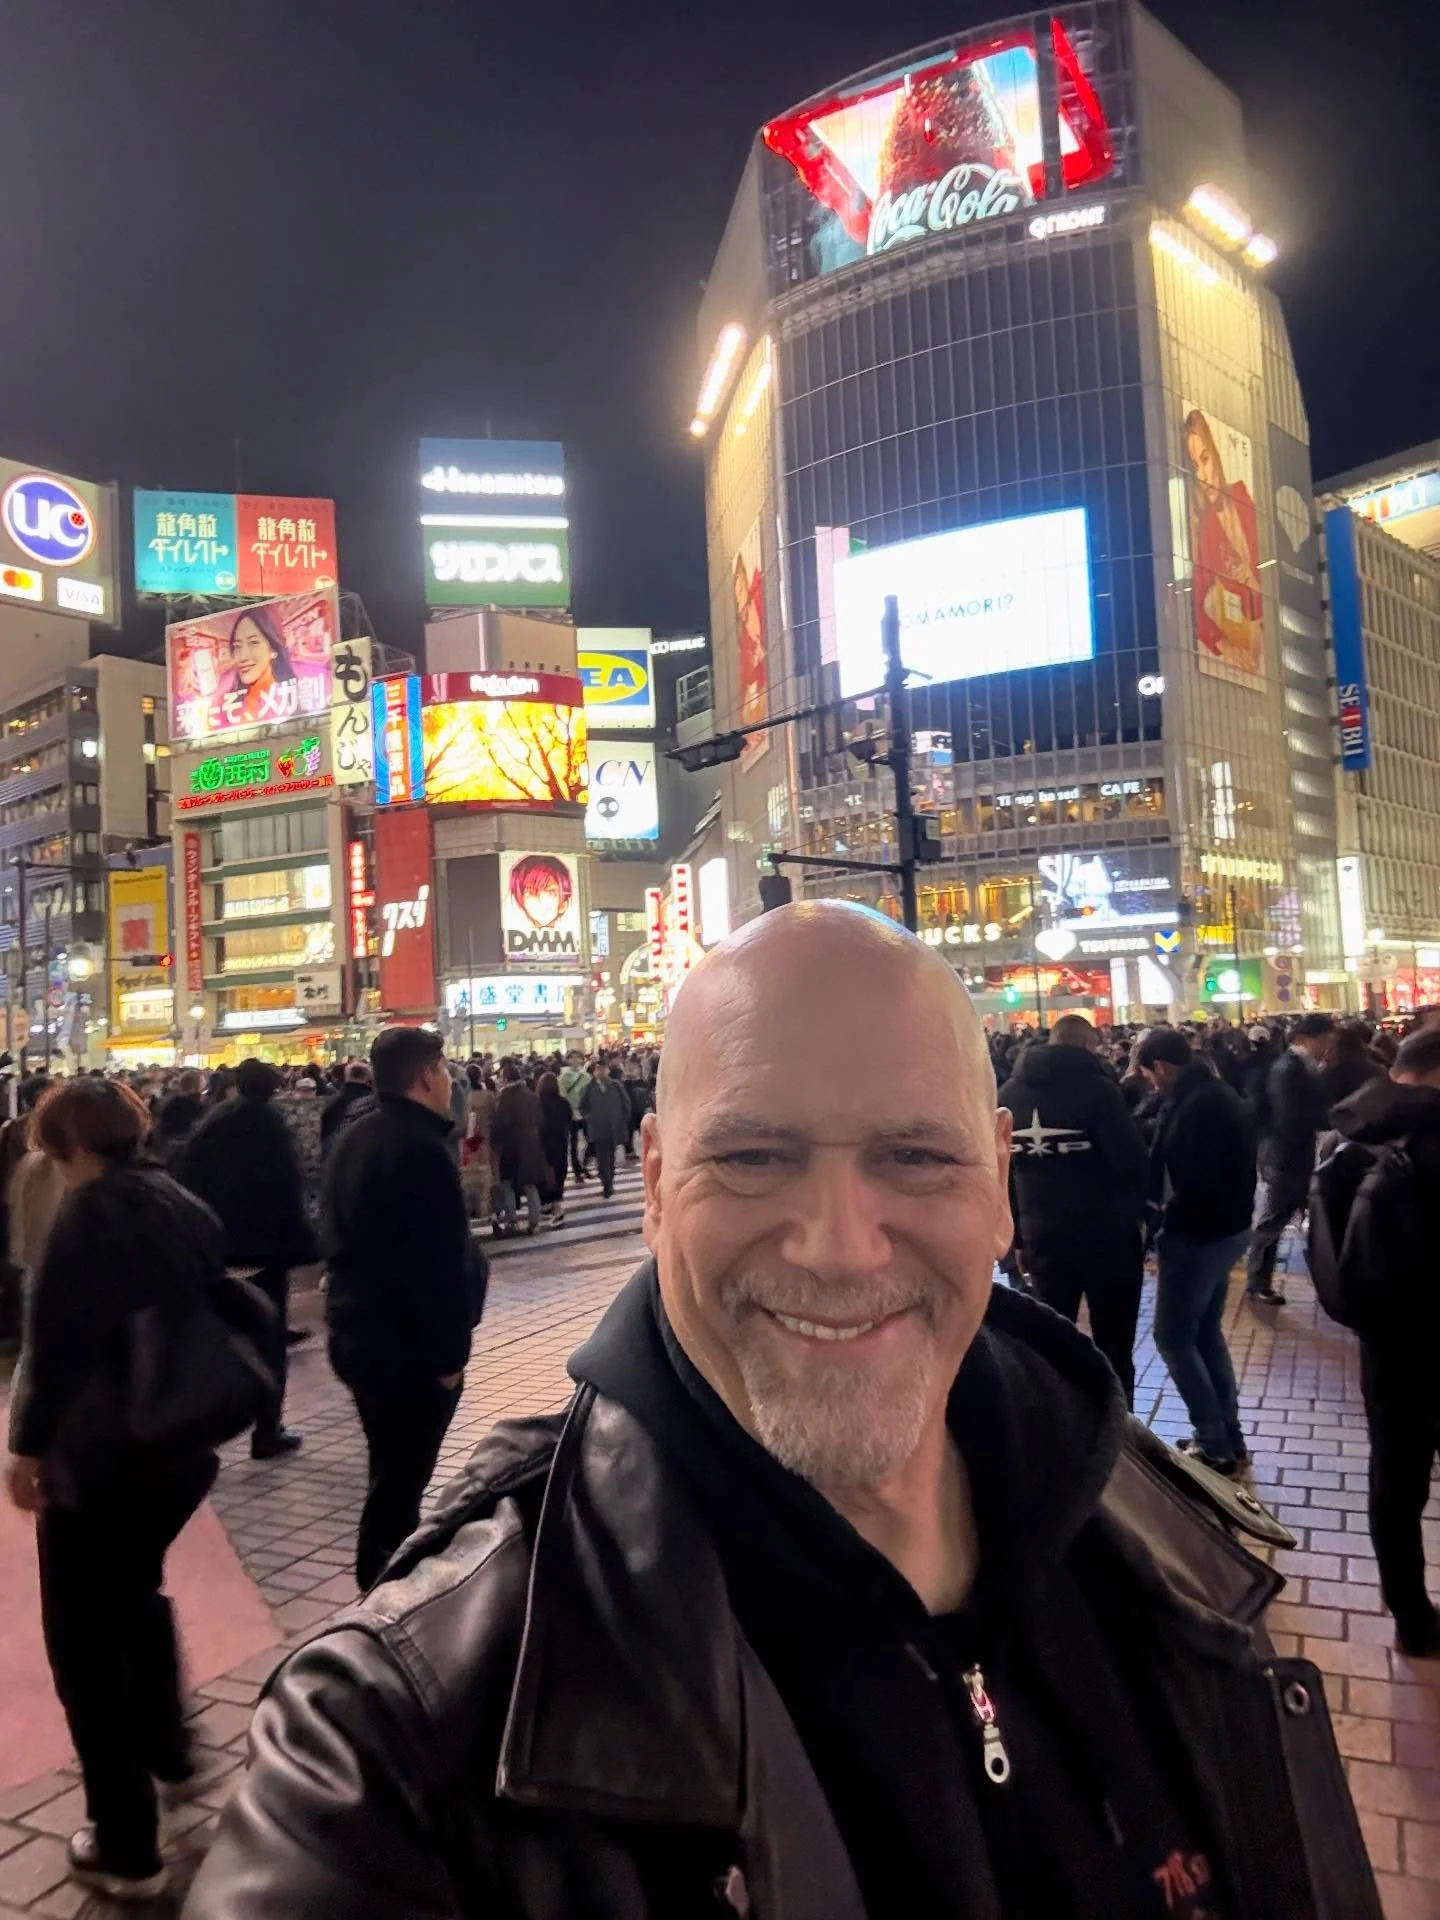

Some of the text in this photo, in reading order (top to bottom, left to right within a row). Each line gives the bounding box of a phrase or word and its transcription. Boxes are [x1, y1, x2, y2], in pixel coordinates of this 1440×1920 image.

[866, 163, 1026, 255] Coca-Cola
[156, 512, 218, 538] 龍角散
[257, 516, 317, 542] 龍角散
[1100, 781, 1141, 796] CAFE
[508, 929, 577, 953] DMM
[916, 921, 1001, 946] UCKS
